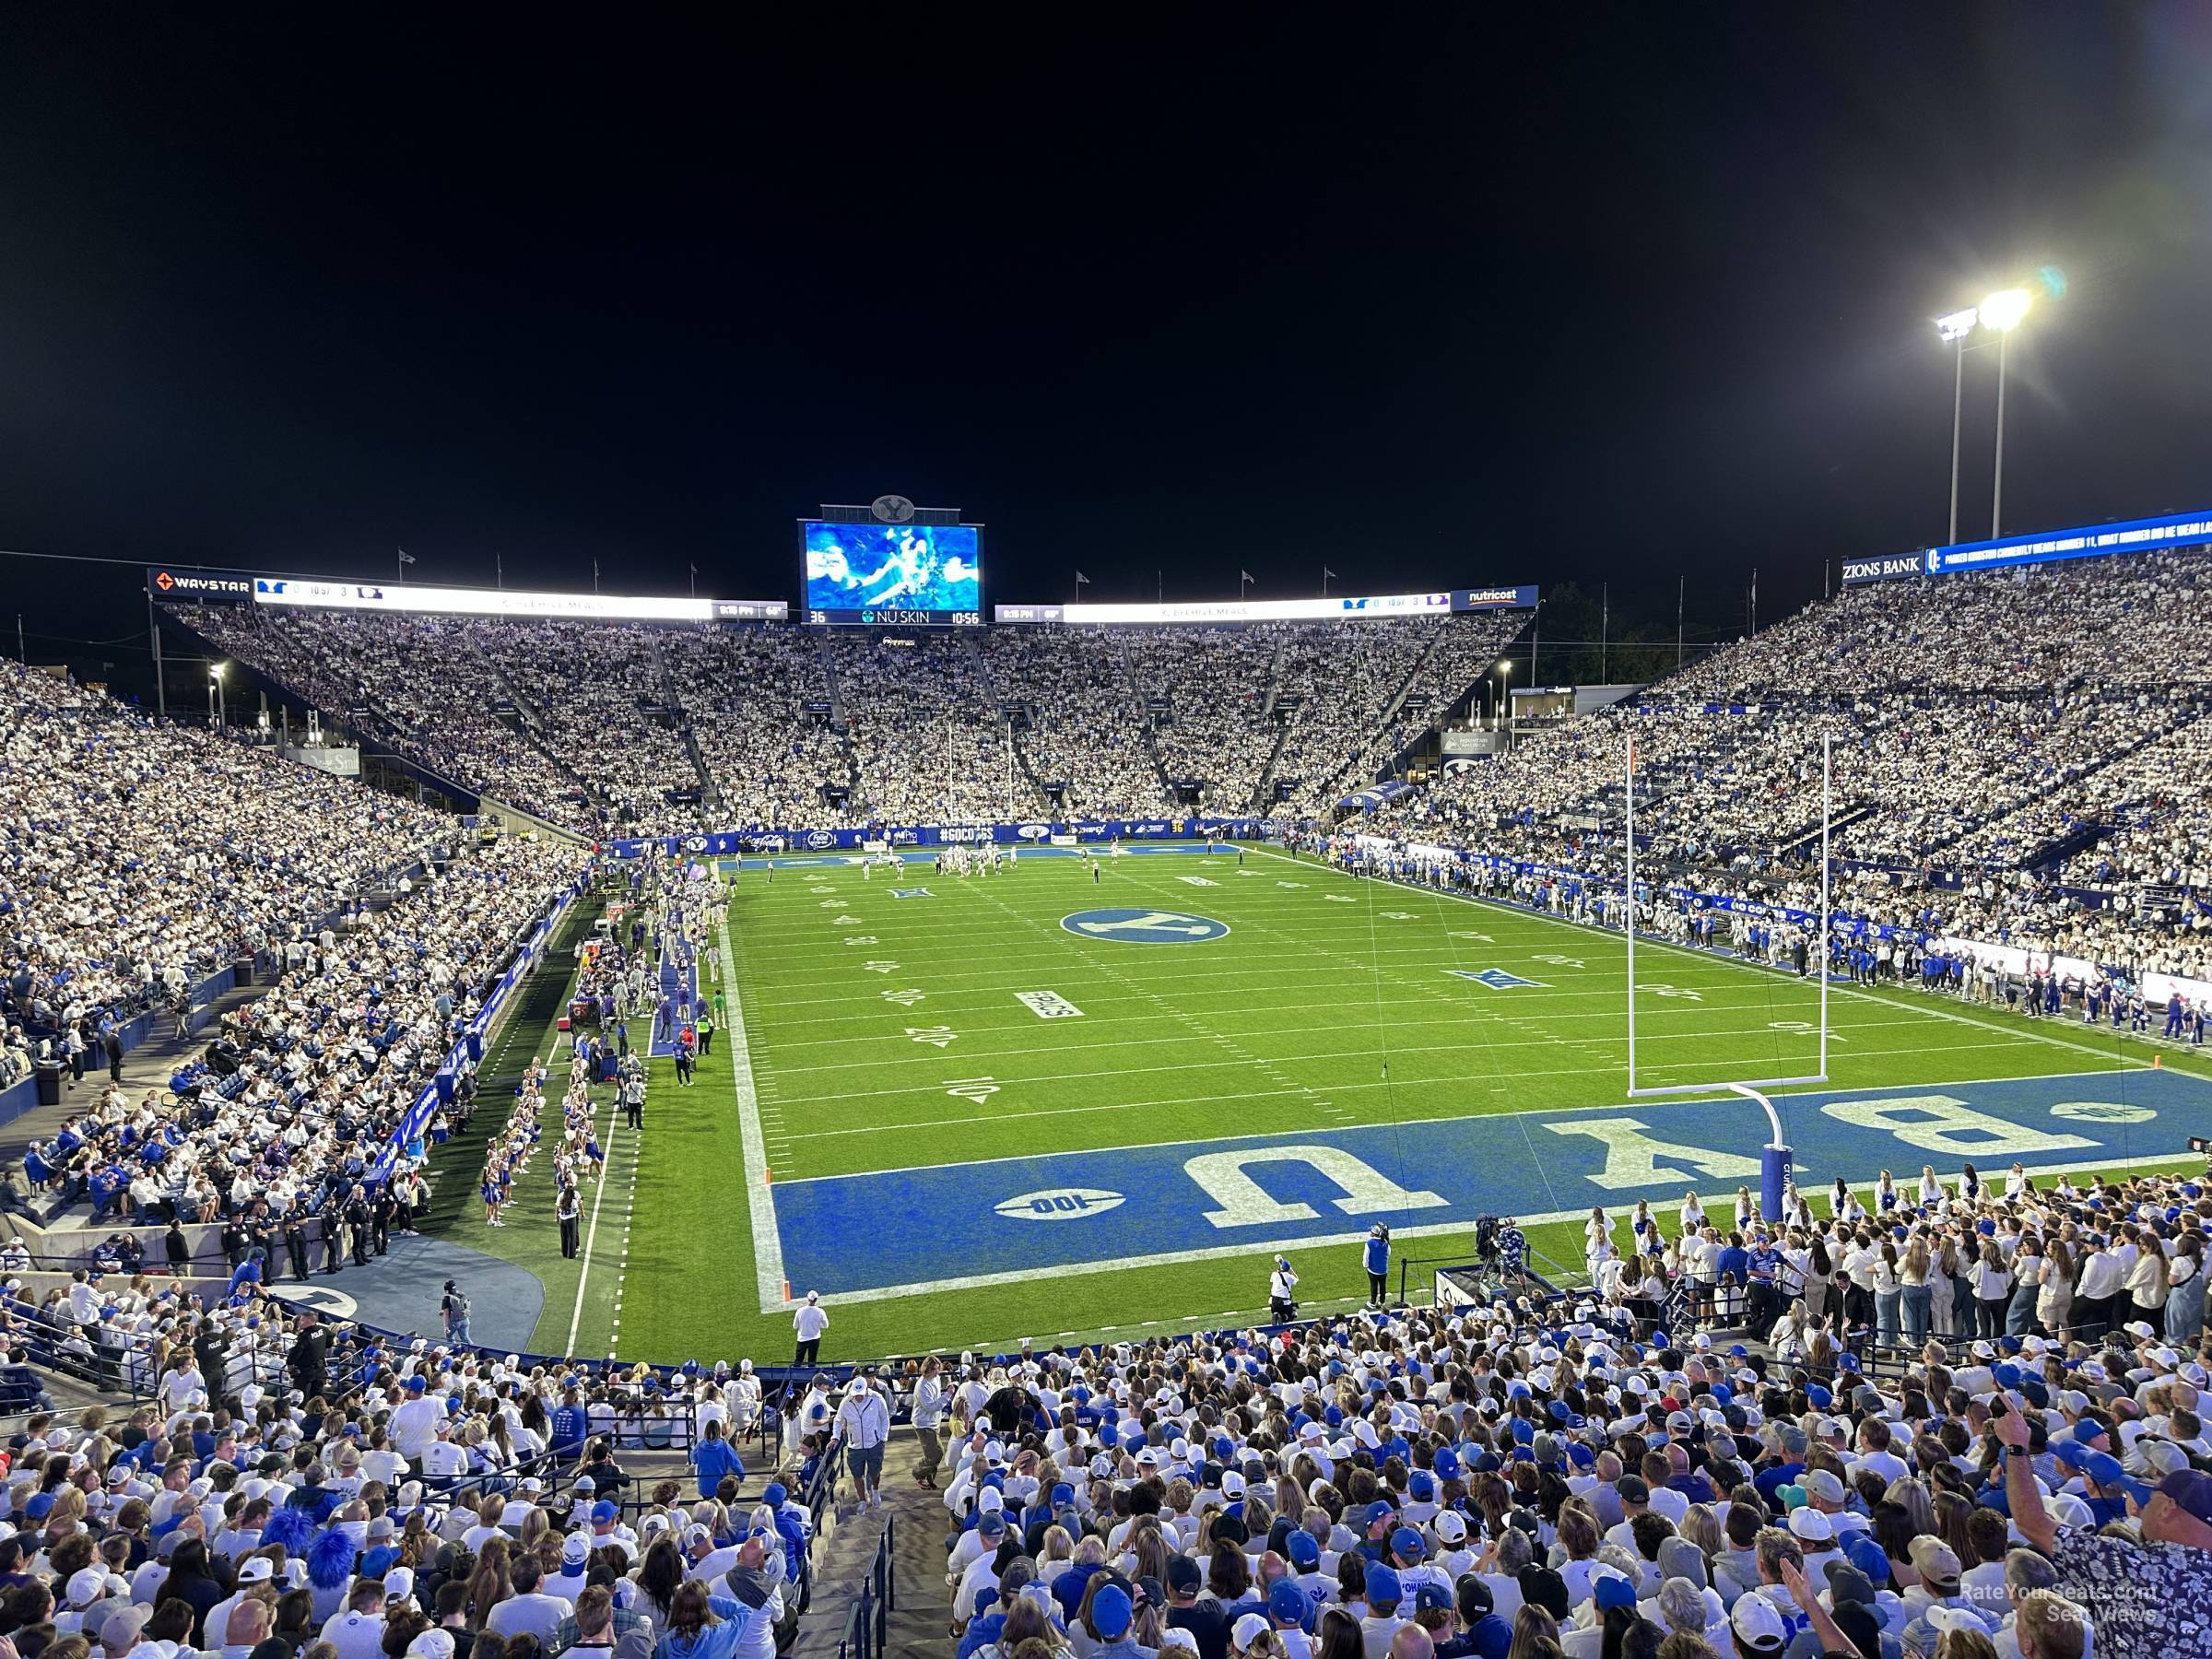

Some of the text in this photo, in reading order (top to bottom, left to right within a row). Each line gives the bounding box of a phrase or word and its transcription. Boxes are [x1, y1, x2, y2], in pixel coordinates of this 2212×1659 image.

[1843, 557, 1920, 579] ZIONS BANK
[173, 577, 250, 593] WAYSTAR
[1469, 589, 1517, 602] nutricost
[810, 610, 826, 623] 36
[877, 611, 929, 623] NU SKIN
[952, 613, 979, 624] 10:56
[940, 828, 994, 842] #GOCOGS
[1172, 824, 1183, 833] 36
[881, 988, 925, 1003] 30
[904, 1026, 959, 1042] 20
[942, 1077, 1001, 1097] 10
[1030, 1194, 1095, 1214] 100
[311, 1329, 324, 1340] POLICE
[207, 1339, 222, 1350] POLICE
